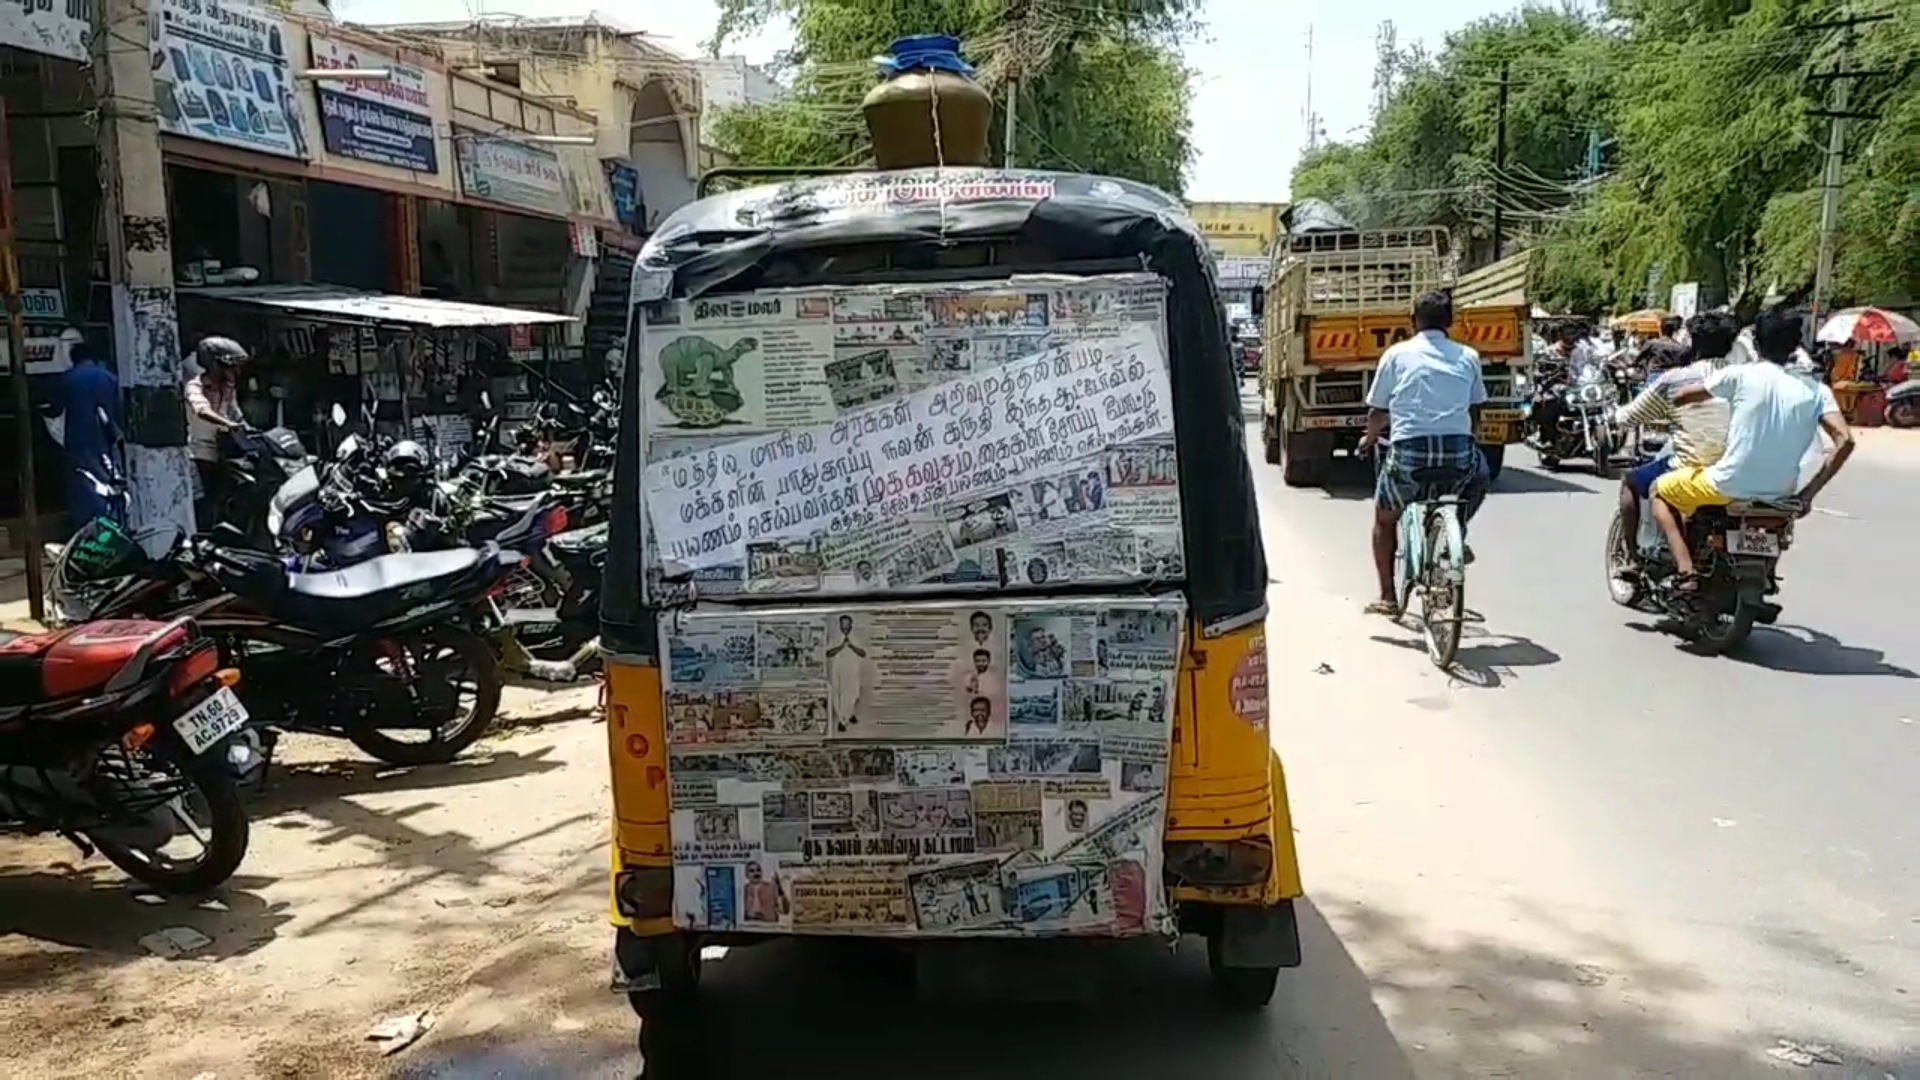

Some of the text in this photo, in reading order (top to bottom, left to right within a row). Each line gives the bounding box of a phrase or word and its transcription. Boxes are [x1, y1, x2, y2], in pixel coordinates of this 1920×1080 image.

[680, 472, 767, 524] மக்களின்
[777, 447, 875, 497] பாதுகாப்பு
[881, 425, 933, 461] நலன்
[942, 403, 994, 444] கருதி
[671, 513, 743, 560] பயணம்
[188, 699, 224, 728] TN.60
[194, 708, 241, 748] AC.9729
